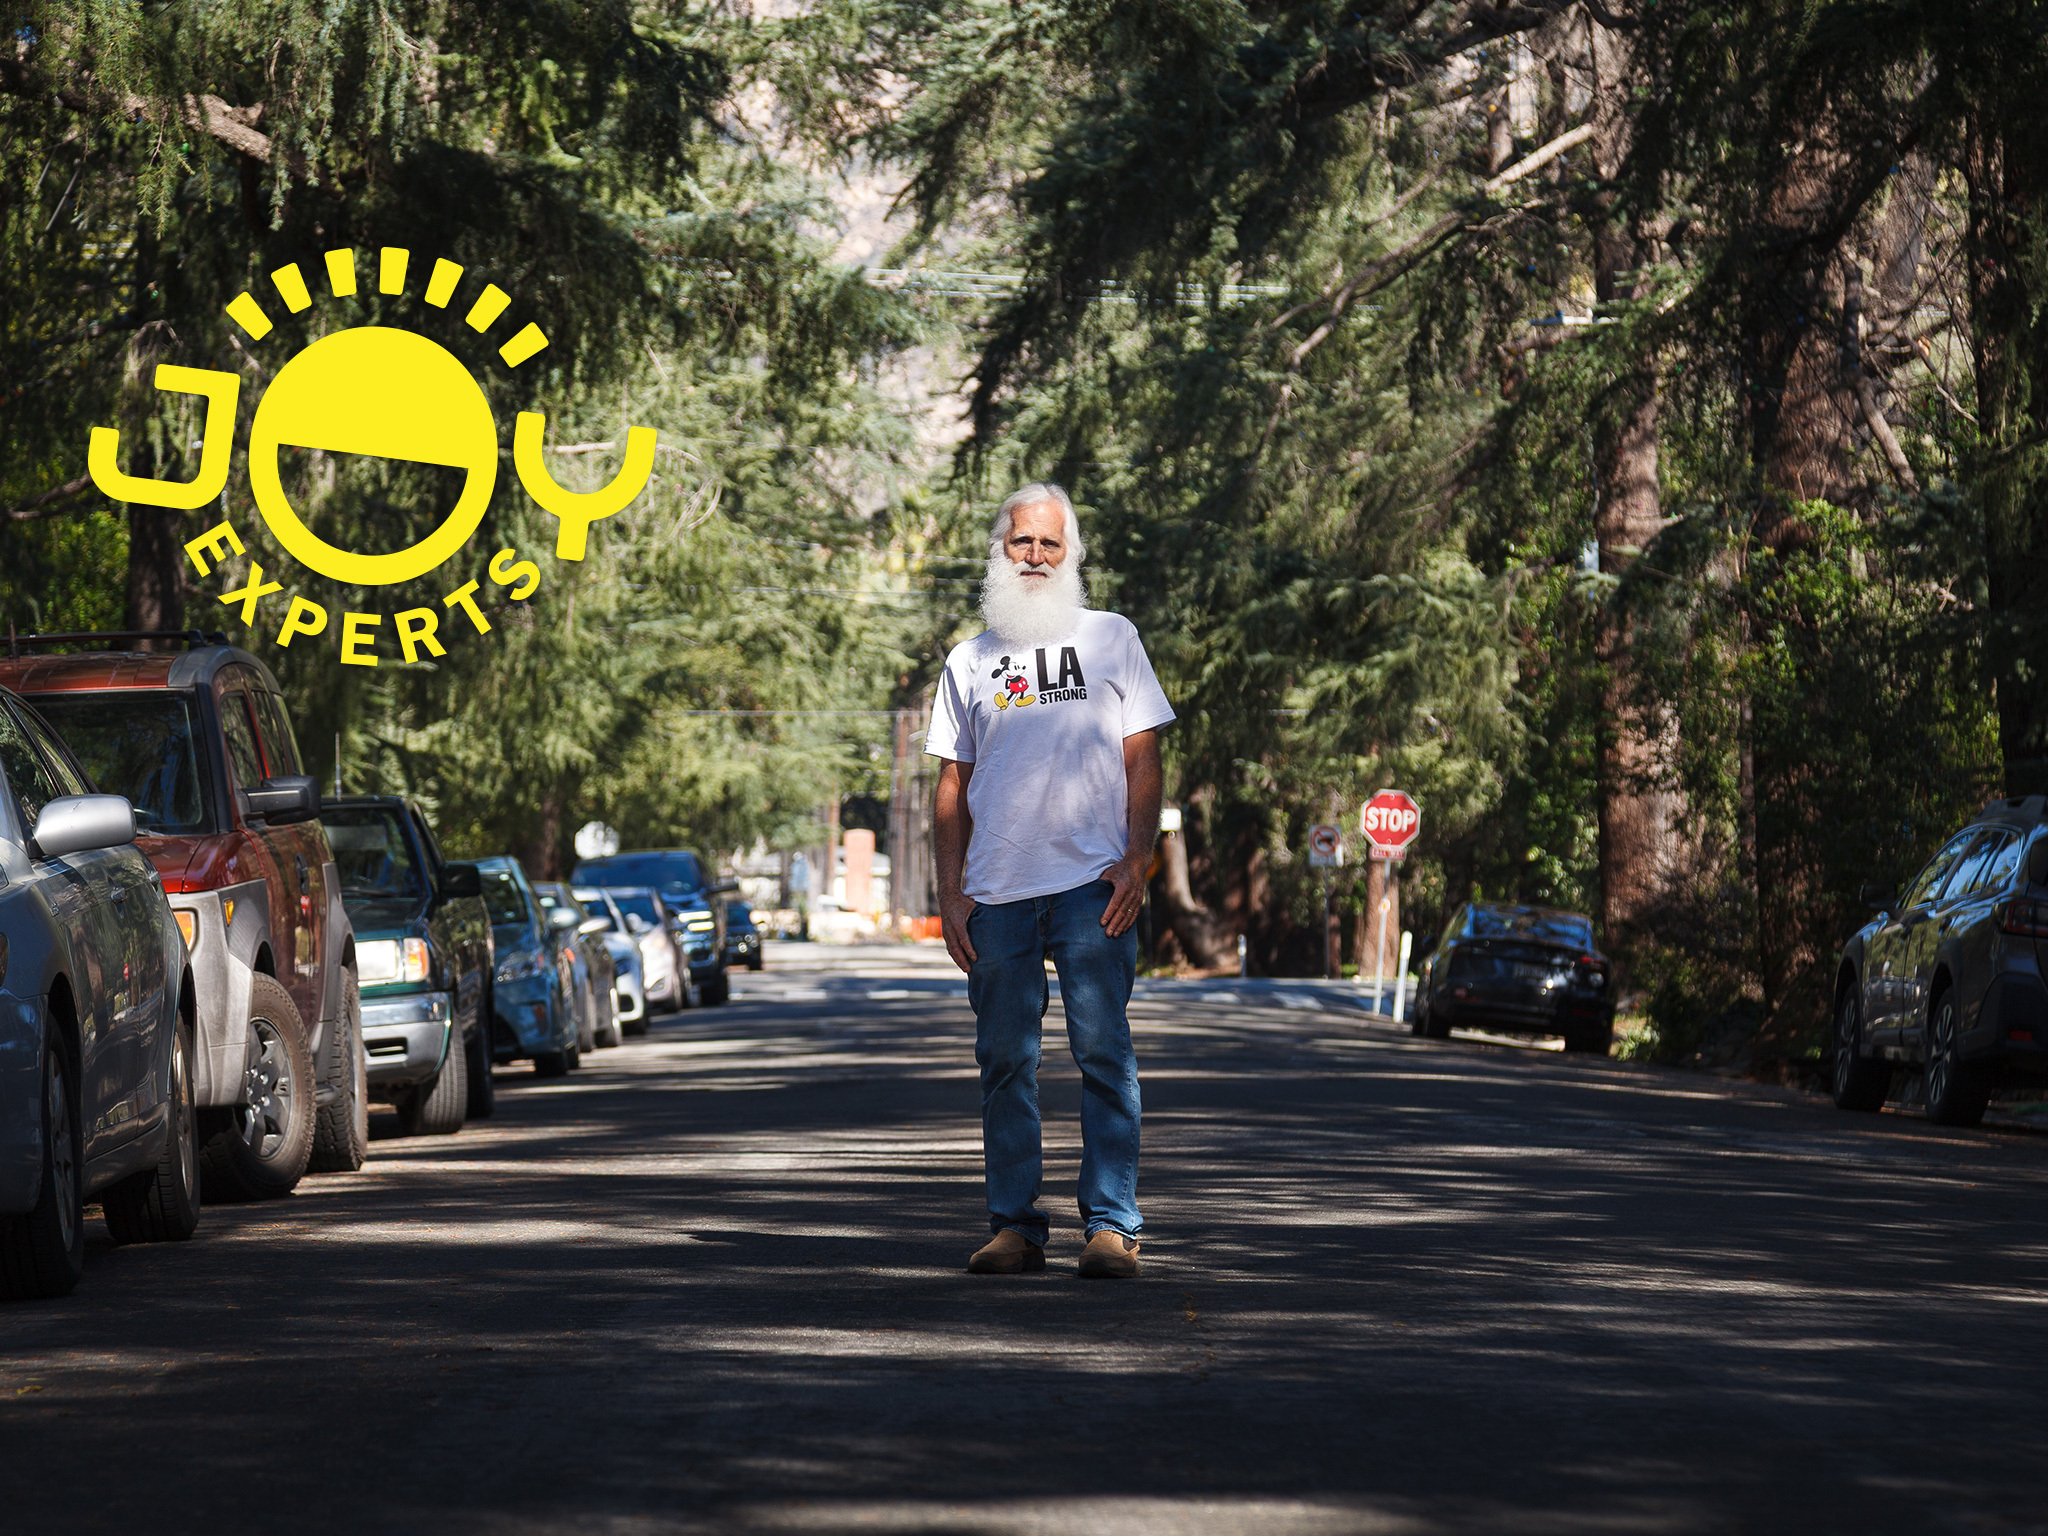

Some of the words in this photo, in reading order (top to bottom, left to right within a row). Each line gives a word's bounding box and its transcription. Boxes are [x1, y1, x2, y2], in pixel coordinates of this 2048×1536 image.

[1035, 646, 1086, 692] LA
[1039, 687, 1088, 704] STRONG
[1365, 806, 1416, 832] STOP
